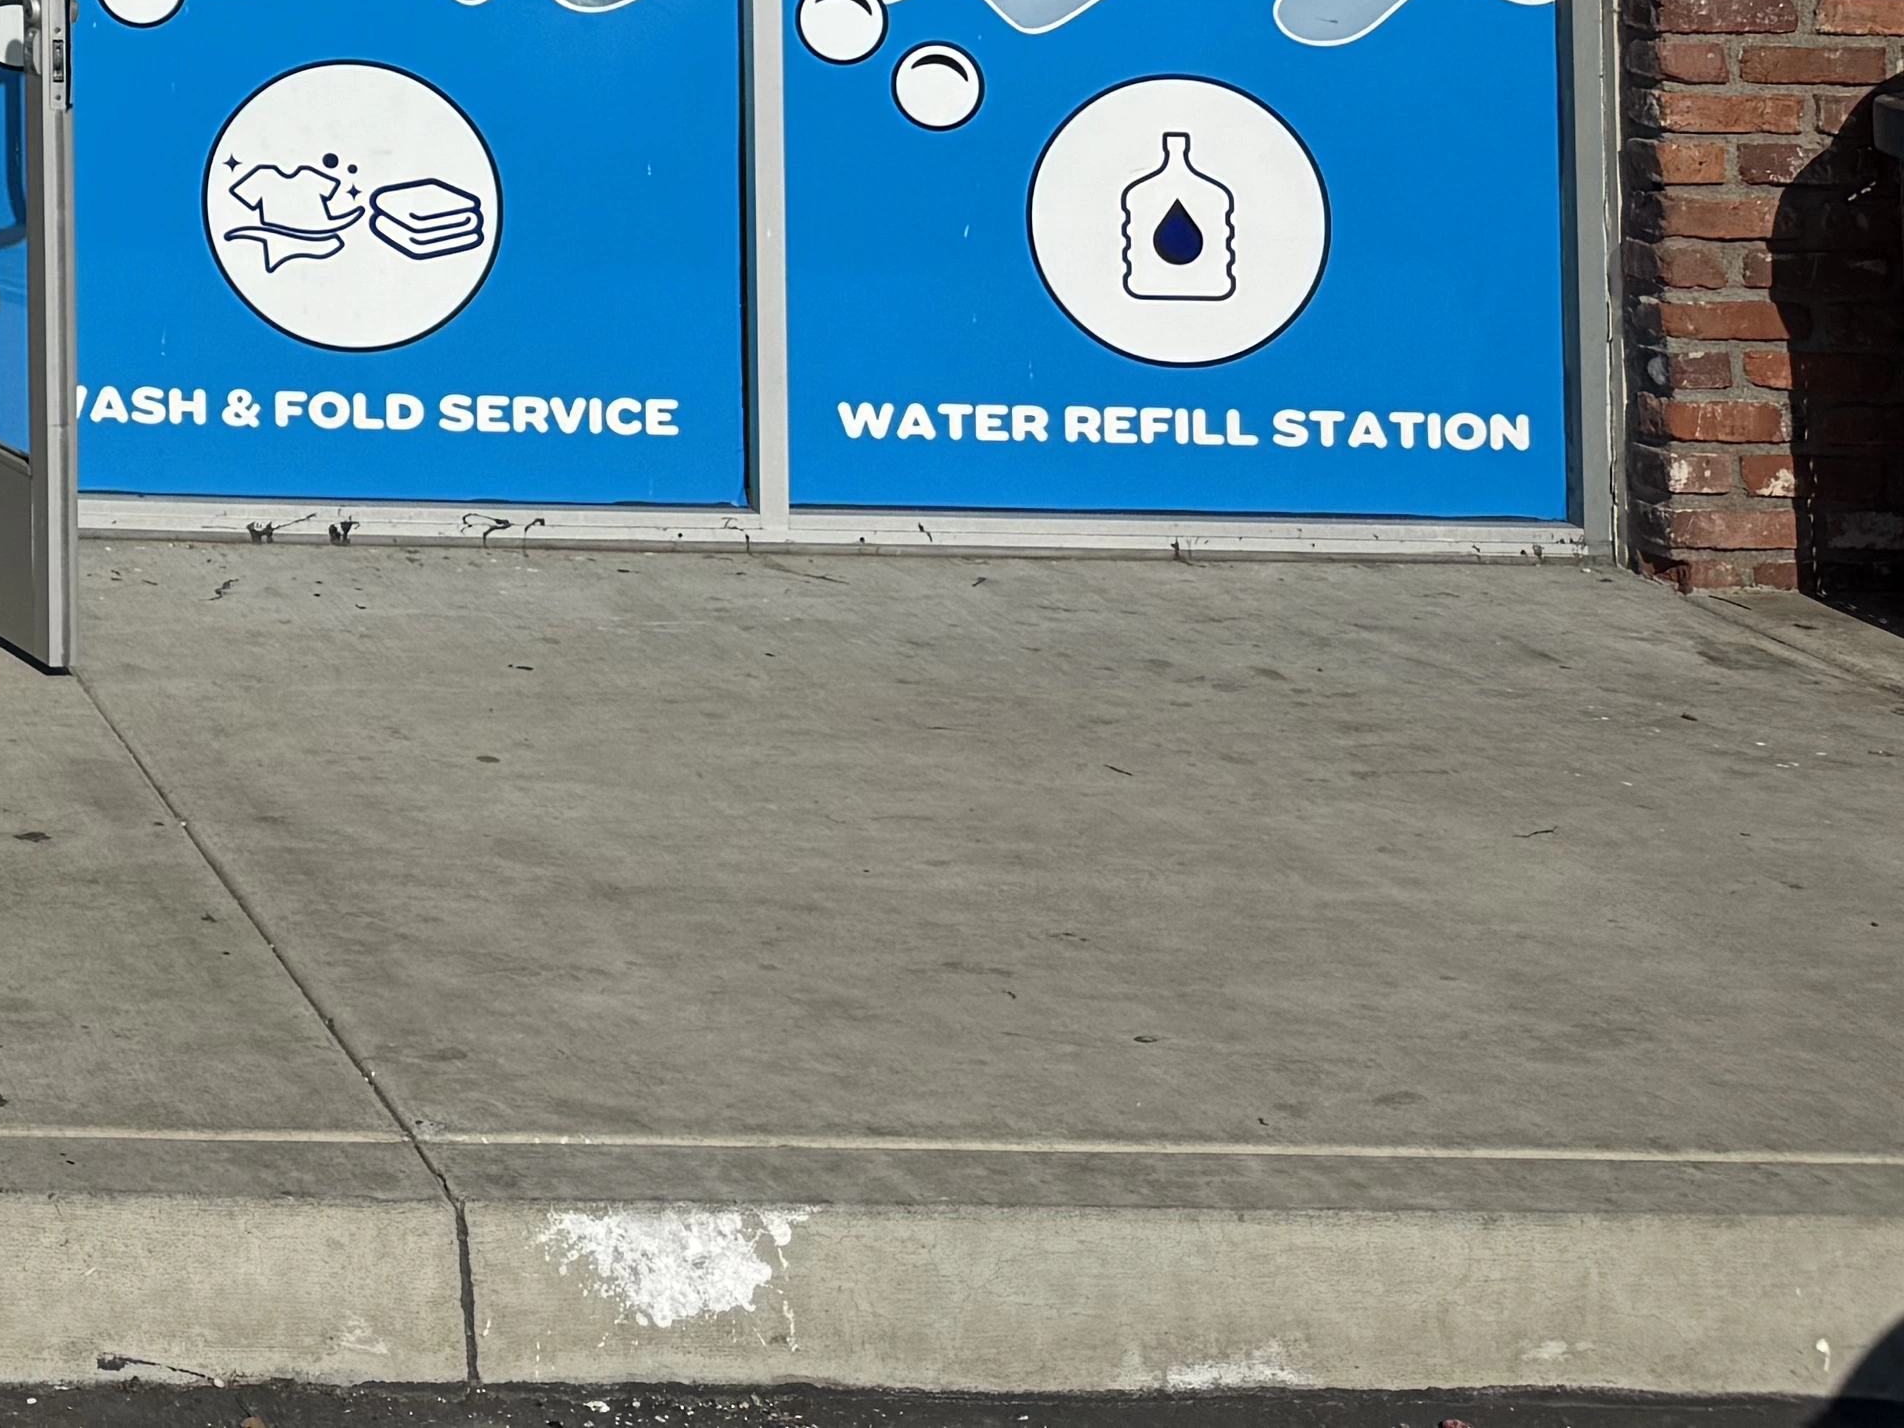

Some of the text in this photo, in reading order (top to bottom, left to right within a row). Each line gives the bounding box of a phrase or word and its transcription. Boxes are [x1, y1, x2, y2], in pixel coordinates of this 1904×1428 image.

[76, 385, 679, 436] ASH & FOLD SERVICE
[837, 402, 1530, 452] WATER REFILL STATION
